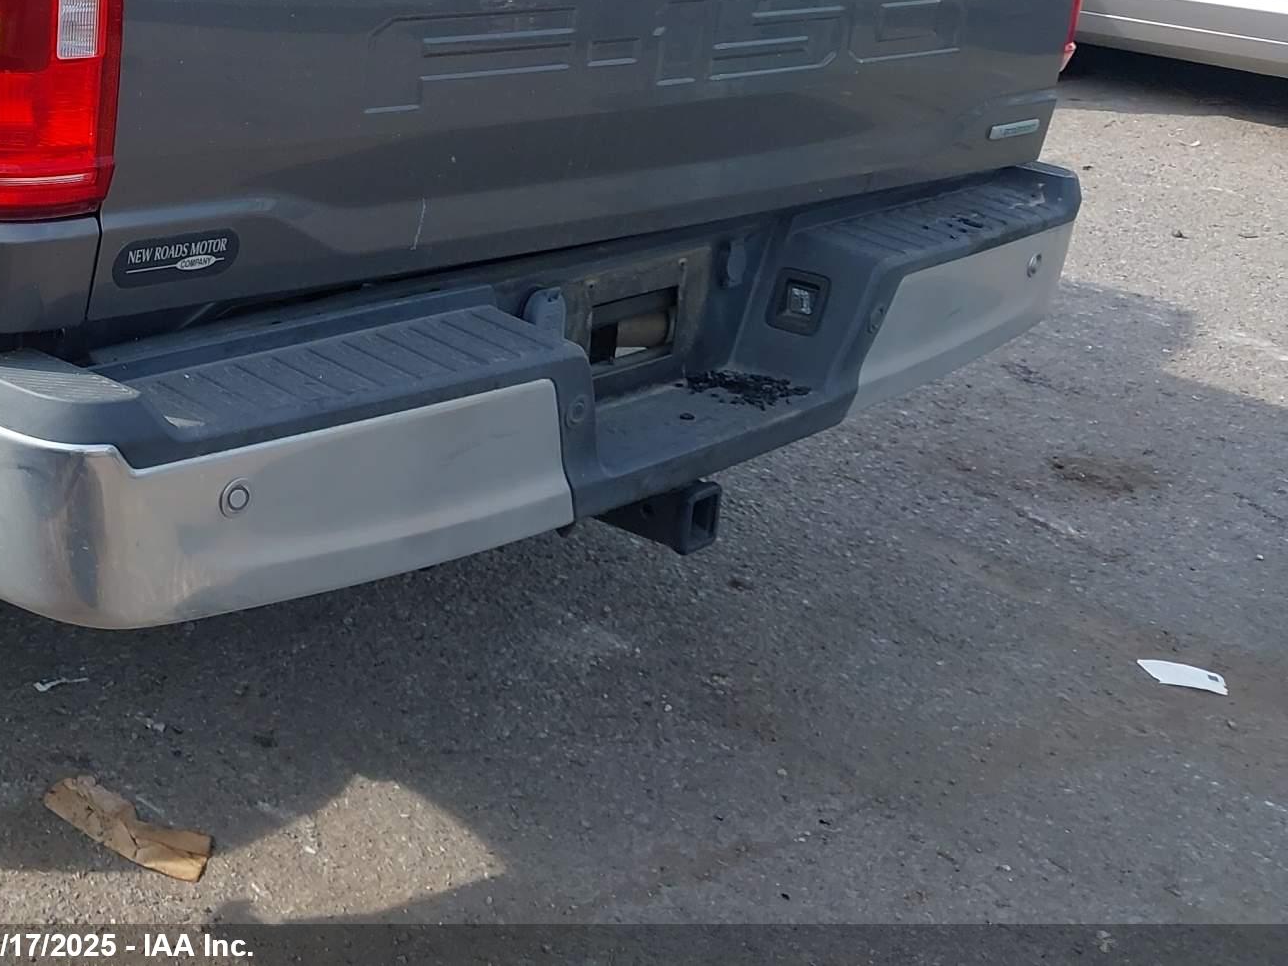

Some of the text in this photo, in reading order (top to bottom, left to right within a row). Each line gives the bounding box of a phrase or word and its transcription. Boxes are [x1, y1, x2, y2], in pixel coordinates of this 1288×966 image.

[128, 238, 227, 264] NEW ROADS MOTOR
[180, 257, 212, 268] COMPANY
